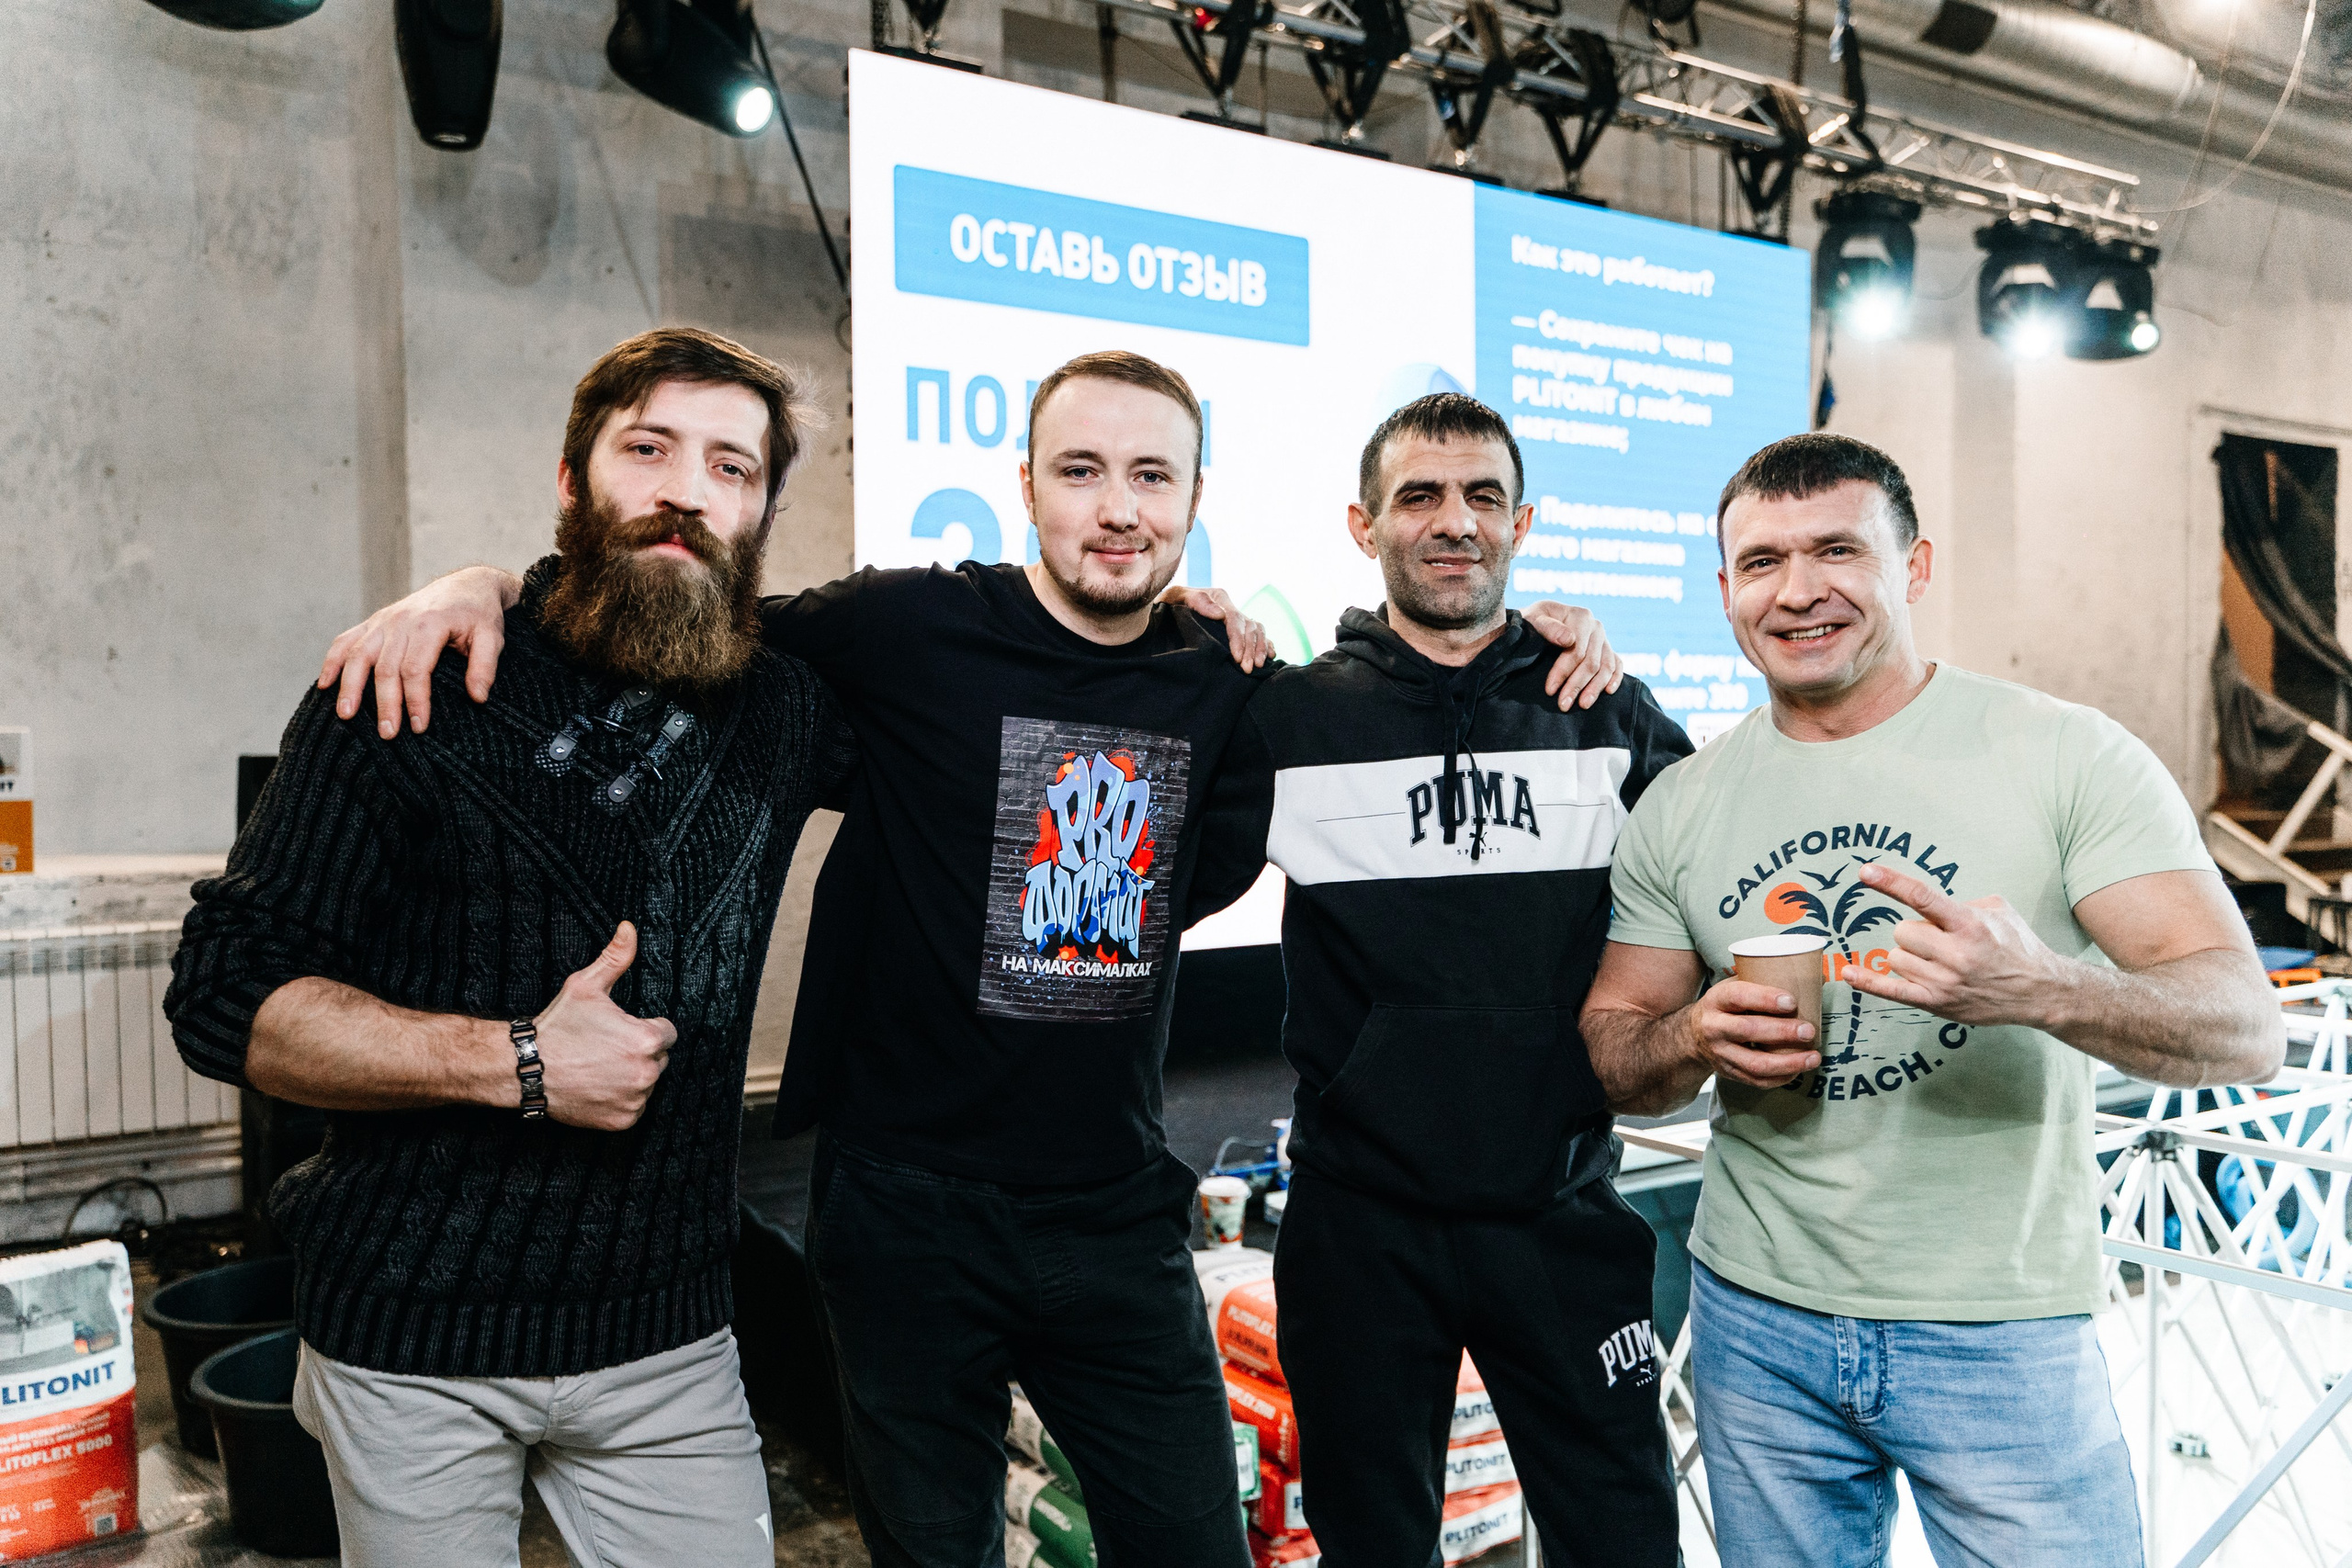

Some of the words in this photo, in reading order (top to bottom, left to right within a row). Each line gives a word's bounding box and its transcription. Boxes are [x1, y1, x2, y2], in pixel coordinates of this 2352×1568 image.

[950, 213, 1121, 285] ОСТАВЬ
[1127, 243, 1268, 307] ОТЗЫВ
[1512, 235, 1557, 269] Как
[1560, 249, 1601, 276] это
[1046, 750, 1151, 872] PRO
[1406, 768, 1542, 847] PUMA
[1456, 847, 1502, 856] SPRTS
[1718, 823, 1912, 919] CALIFORNIA
[1001, 955, 1028, 974] НА
[1033, 957, 1152, 978] МАКСИМАЛКАХ
[1599, 1319, 1656, 1388] PUM
[1, 1360, 117, 1406] LITONIT
[1452, 1401, 1495, 1421] PLITO
